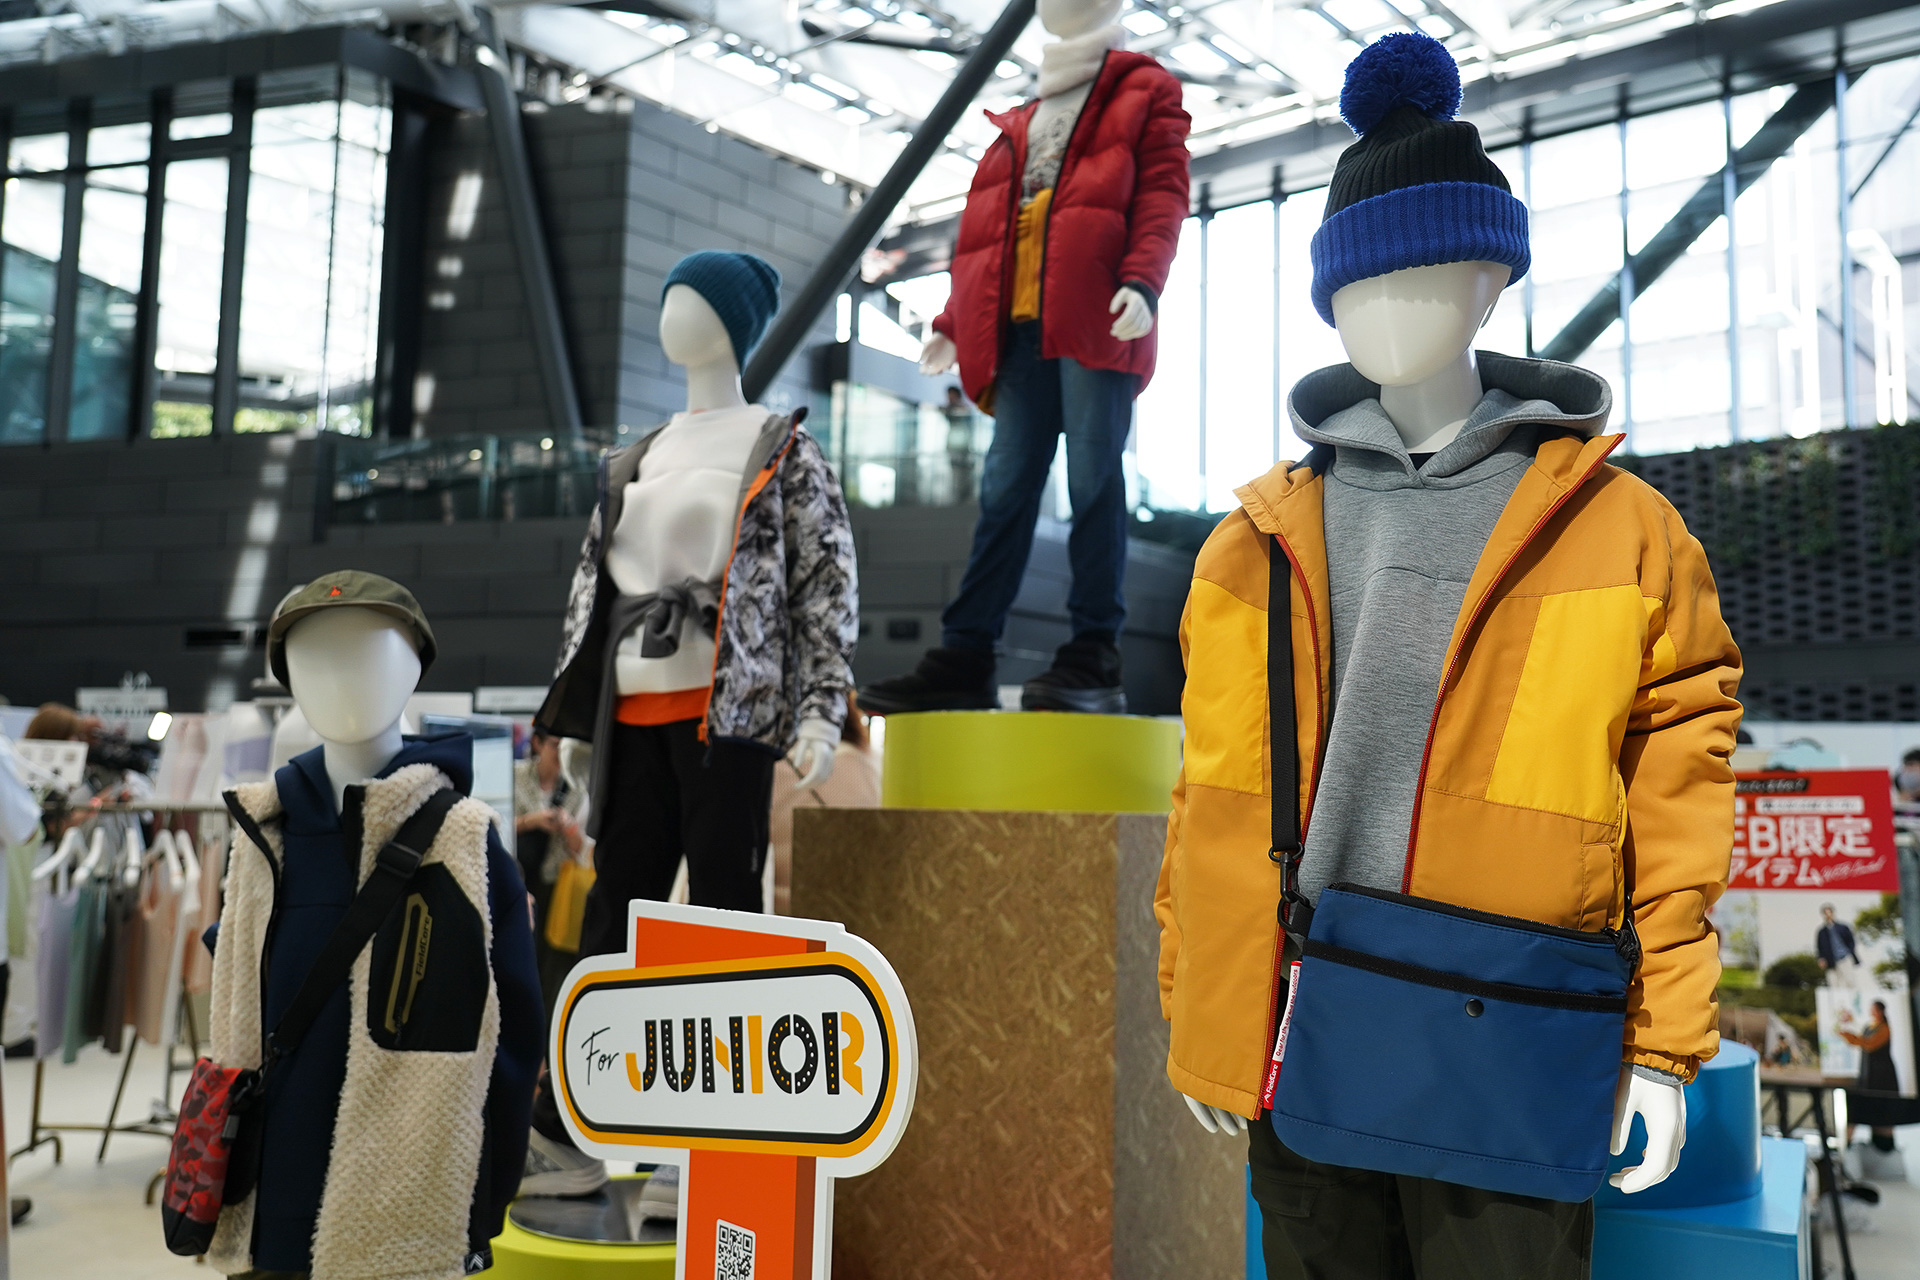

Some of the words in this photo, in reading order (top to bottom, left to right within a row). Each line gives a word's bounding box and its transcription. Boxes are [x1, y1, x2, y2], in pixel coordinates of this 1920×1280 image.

[415, 916, 430, 976] FieldCore
[581, 1026, 620, 1086] For
[625, 1011, 865, 1096] JUNIOR
[1275, 1043, 1284, 1057] Gear
[1266, 1064, 1279, 1093] FieldCore
